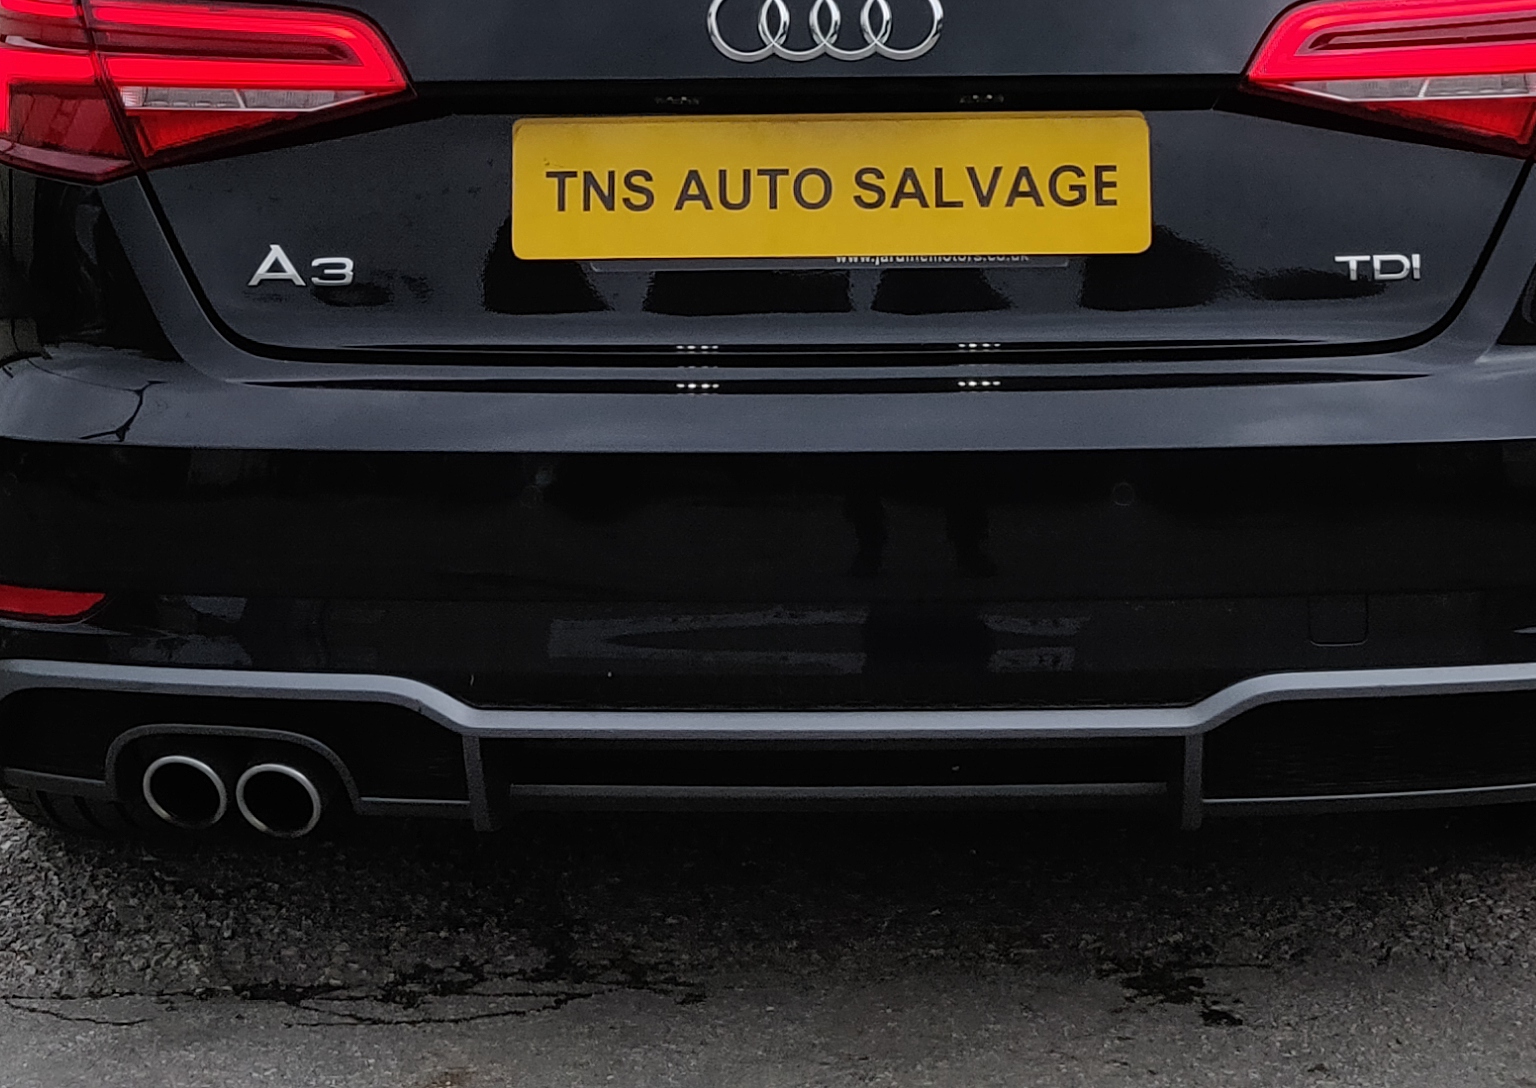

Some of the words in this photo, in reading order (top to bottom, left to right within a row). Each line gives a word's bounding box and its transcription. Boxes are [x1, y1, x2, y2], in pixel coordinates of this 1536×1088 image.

[545, 169, 655, 212] TNS
[674, 167, 833, 211] AUTO
[852, 164, 1118, 210] SALVAGE
[247, 244, 354, 287] A3
[1334, 253, 1421, 281] TDI
